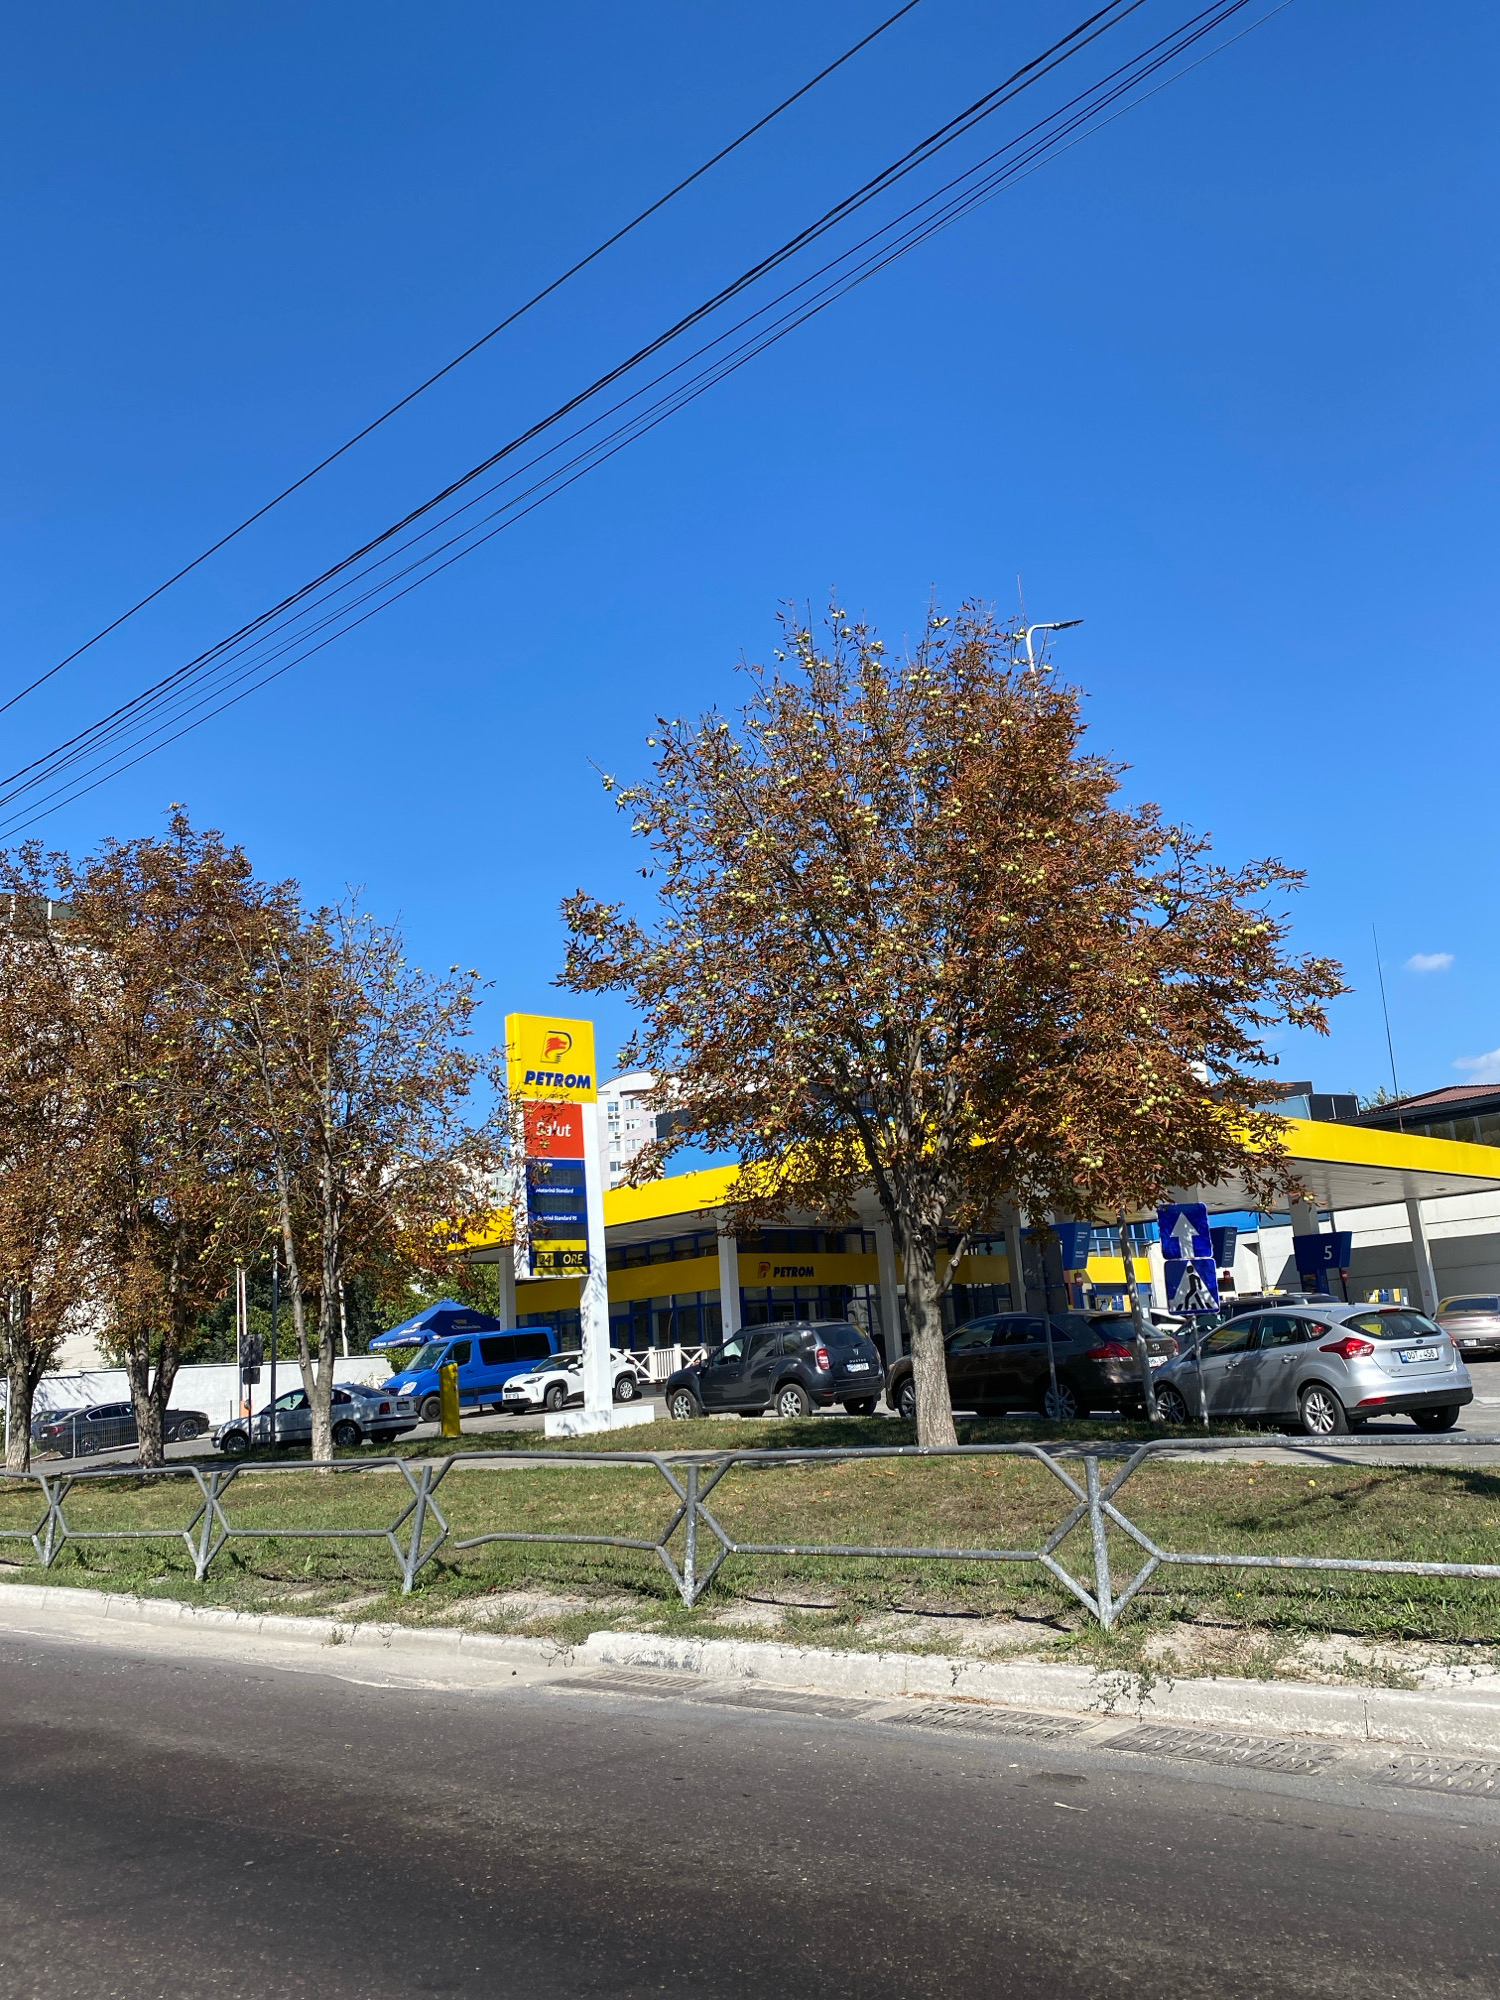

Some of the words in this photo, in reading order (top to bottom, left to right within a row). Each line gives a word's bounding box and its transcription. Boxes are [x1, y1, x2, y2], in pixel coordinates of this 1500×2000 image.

[524, 1070, 591, 1089] PETROM
[536, 1120, 571, 1137] Salut
[539, 1254, 551, 1265] 24
[563, 1253, 583, 1265] ORE
[1323, 1245, 1333, 1260] 5
[773, 1266, 815, 1278] PETROM
